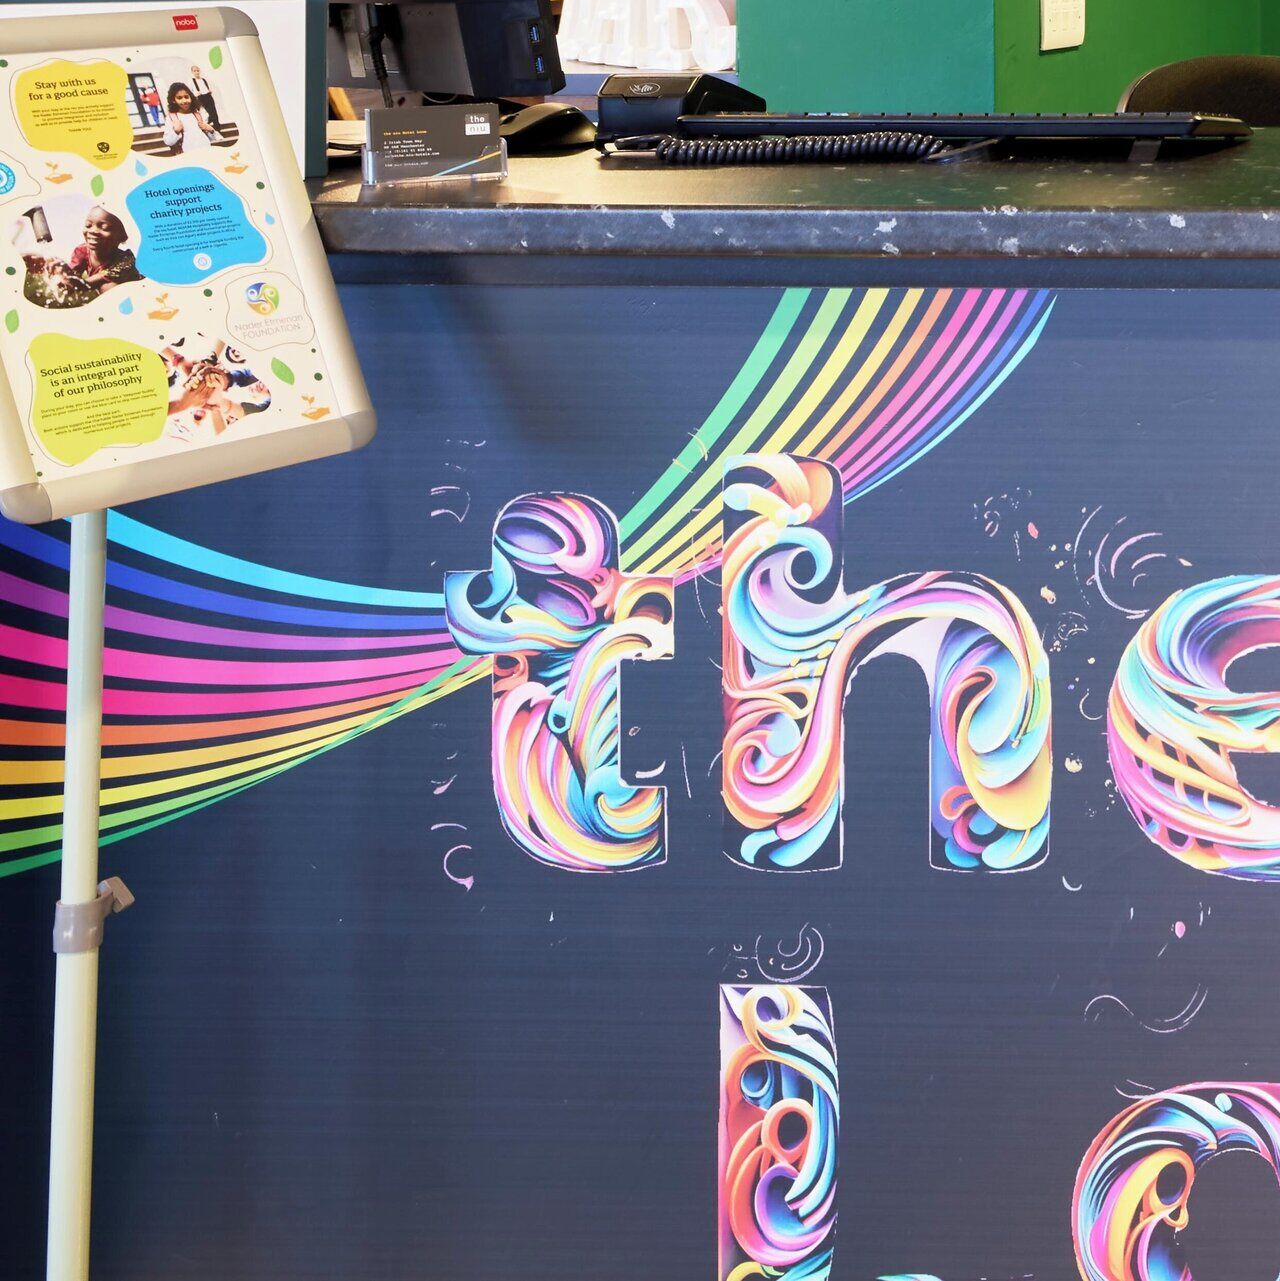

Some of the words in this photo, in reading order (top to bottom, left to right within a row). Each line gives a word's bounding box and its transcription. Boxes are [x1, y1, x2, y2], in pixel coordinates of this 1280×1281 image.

[176, 18, 195, 26] nobo
[59, 79, 83, 87] with
[54, 90, 78, 100] good
[470, 115, 485, 123] the
[470, 125, 486, 133] niu
[145, 188, 171, 198] Hotel
[173, 185, 214, 196] openings
[165, 196, 202, 206] support
[150, 209, 183, 219] charity
[185, 204, 222, 216] projects
[243, 324, 301, 339] FOUNDATION
[40, 364, 72, 377] Social
[75, 353, 141, 371] sustainability
[50, 379, 59, 387] is
[62, 377, 75, 385] an
[77, 368, 116, 382] integral
[119, 365, 139, 376] part
[54, 389, 64, 398] of
[67, 387, 84, 395] our
[87, 376, 142, 393] philosophy
